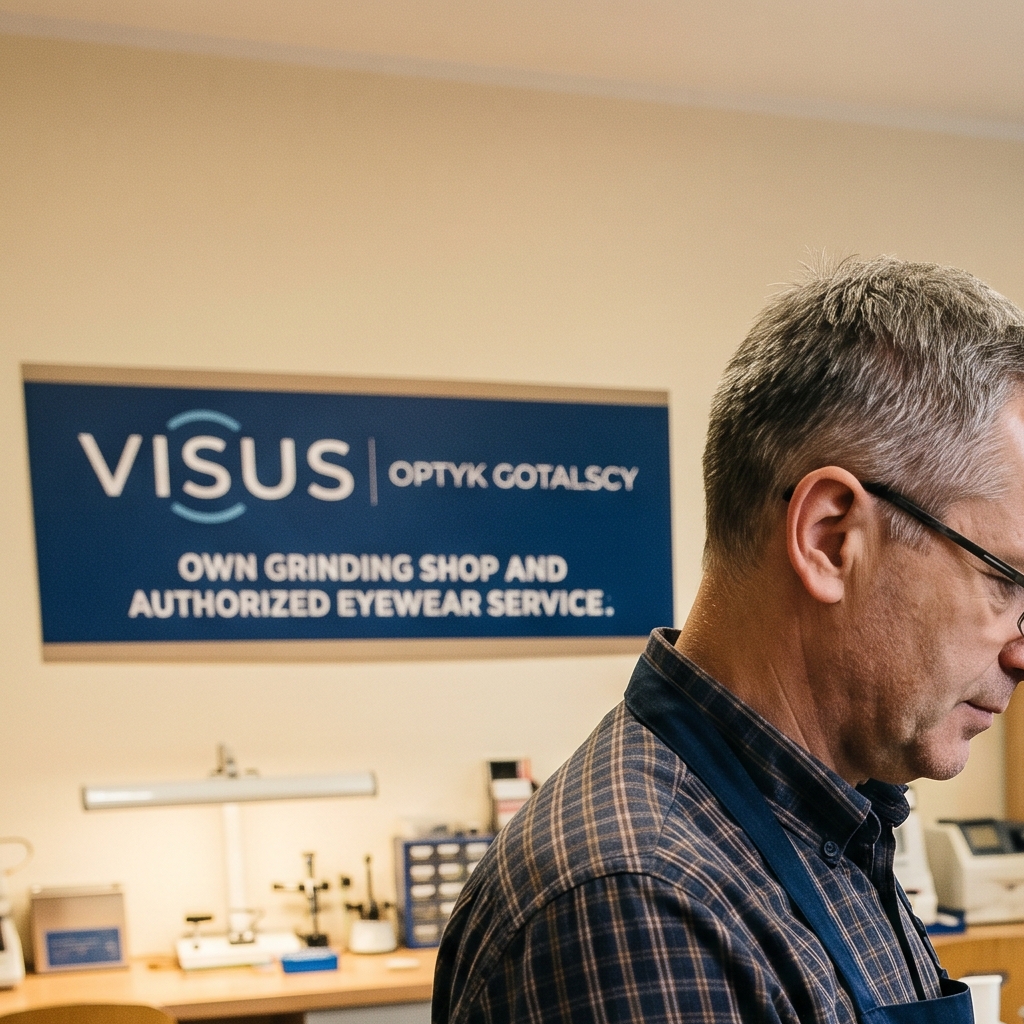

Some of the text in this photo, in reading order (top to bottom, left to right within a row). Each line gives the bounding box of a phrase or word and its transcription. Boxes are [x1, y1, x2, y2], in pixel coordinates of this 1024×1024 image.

[79, 433, 355, 501] VISUS
[388, 460, 639, 492] OPTYK GOTALSCY
[177, 552, 568, 583] OWN GRINDING SHOP AND
[128, 588, 615, 619] AUTHORIZED EYEWEAR SERVICE.
